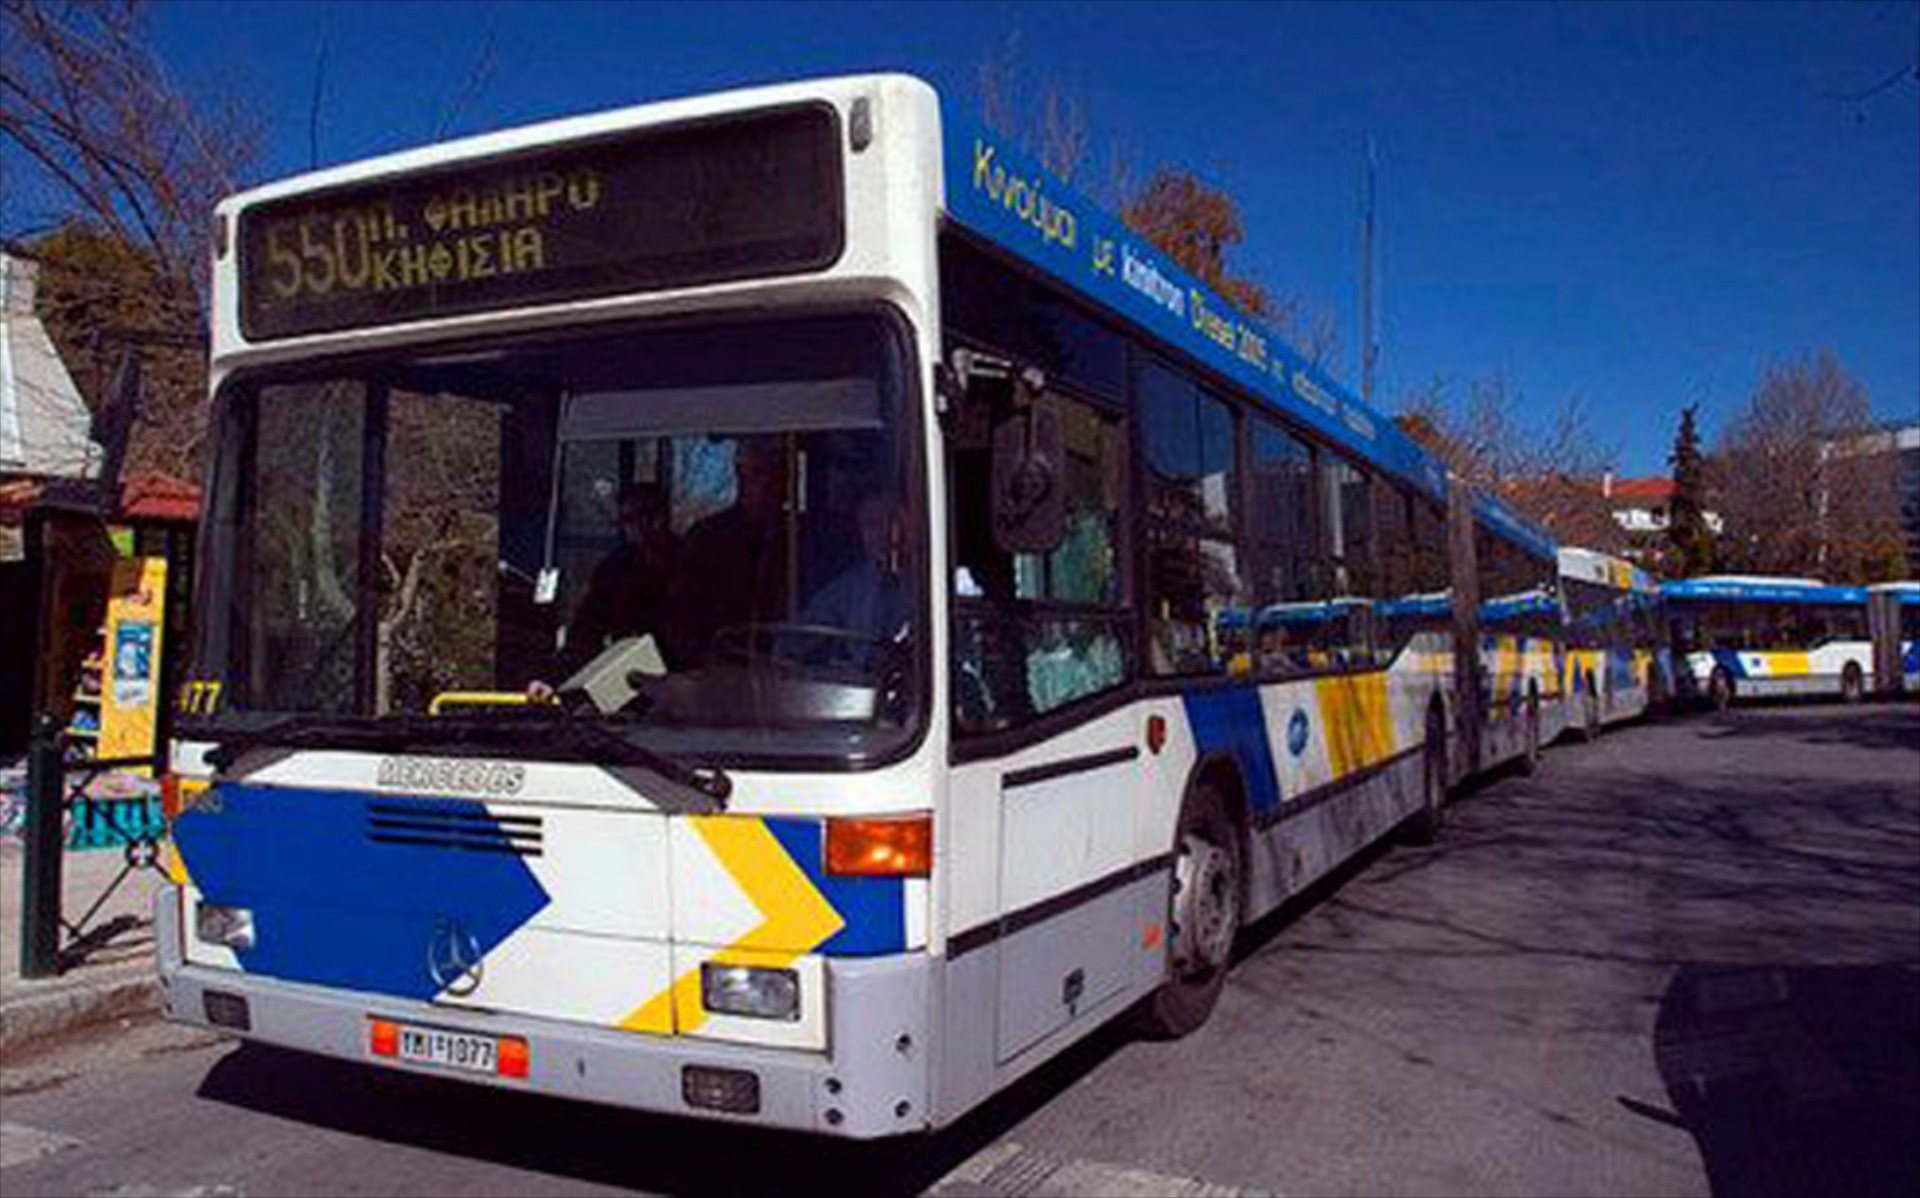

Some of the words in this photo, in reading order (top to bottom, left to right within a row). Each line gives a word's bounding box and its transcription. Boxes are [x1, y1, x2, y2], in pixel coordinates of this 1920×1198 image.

[266, 212, 370, 297] 550
[373, 227, 545, 289] ΚΗΦΙΣΙΑ
[377, 756, 525, 797] MERCEDES
